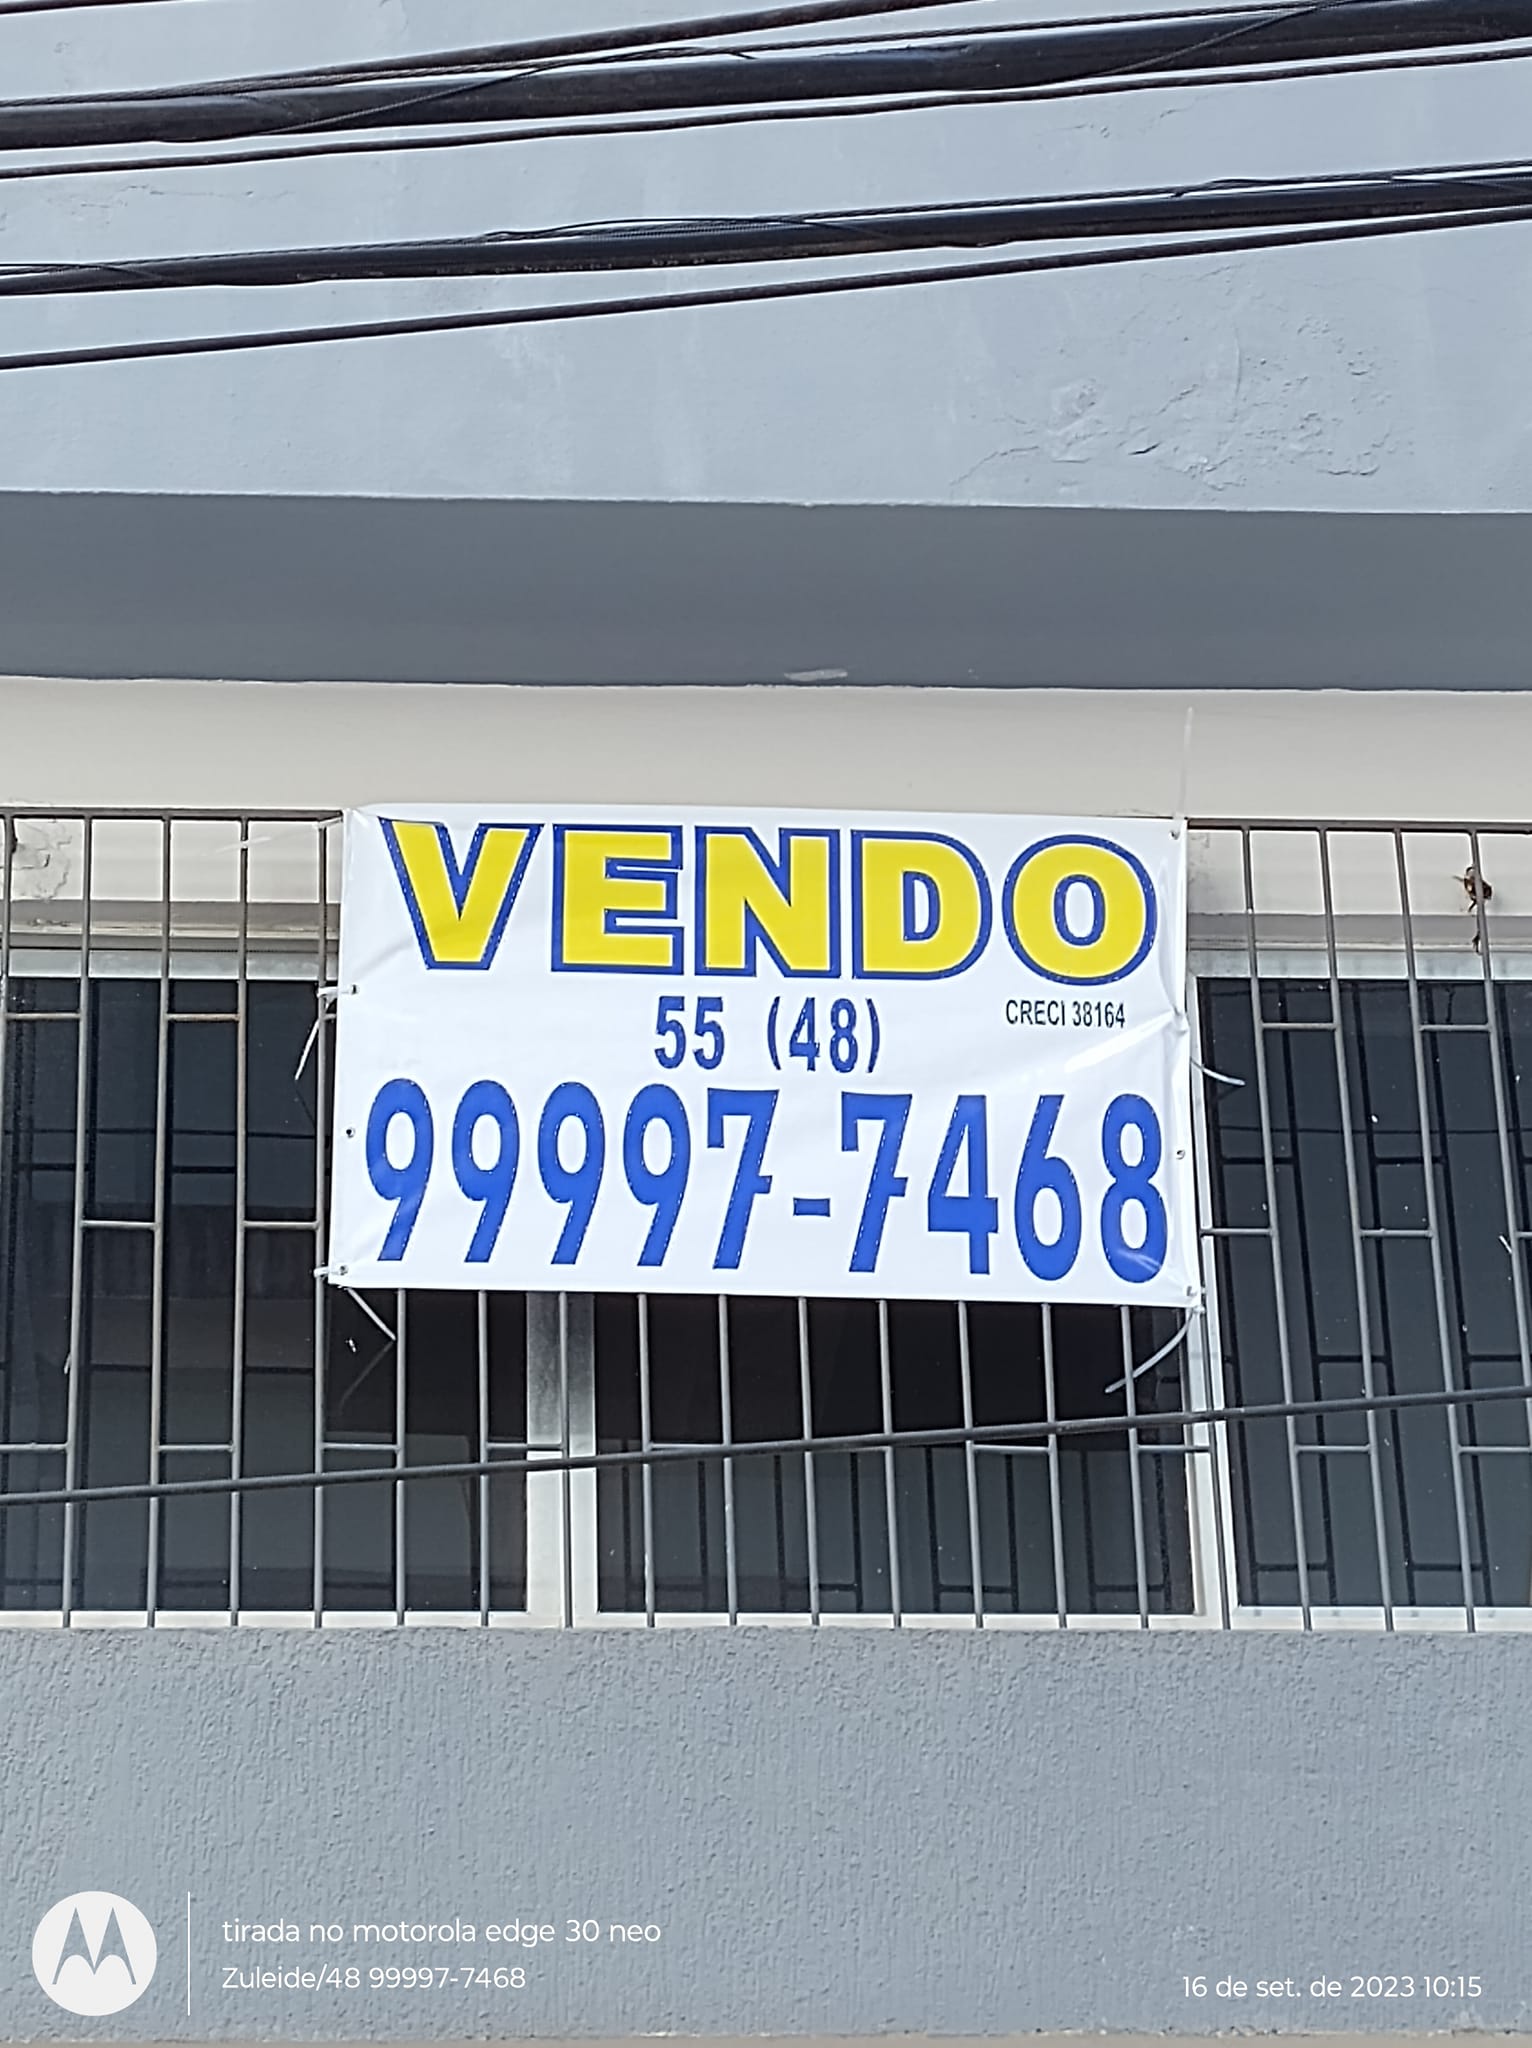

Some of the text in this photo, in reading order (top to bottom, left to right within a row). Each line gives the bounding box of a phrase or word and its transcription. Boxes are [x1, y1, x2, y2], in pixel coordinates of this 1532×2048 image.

[378, 817, 1157, 985] VENDO
[654, 996, 881, 1074] 55 (48)
[1005, 999, 1126, 1029] CRECI 38164
[365, 1078, 1168, 1284] 99997-7468
